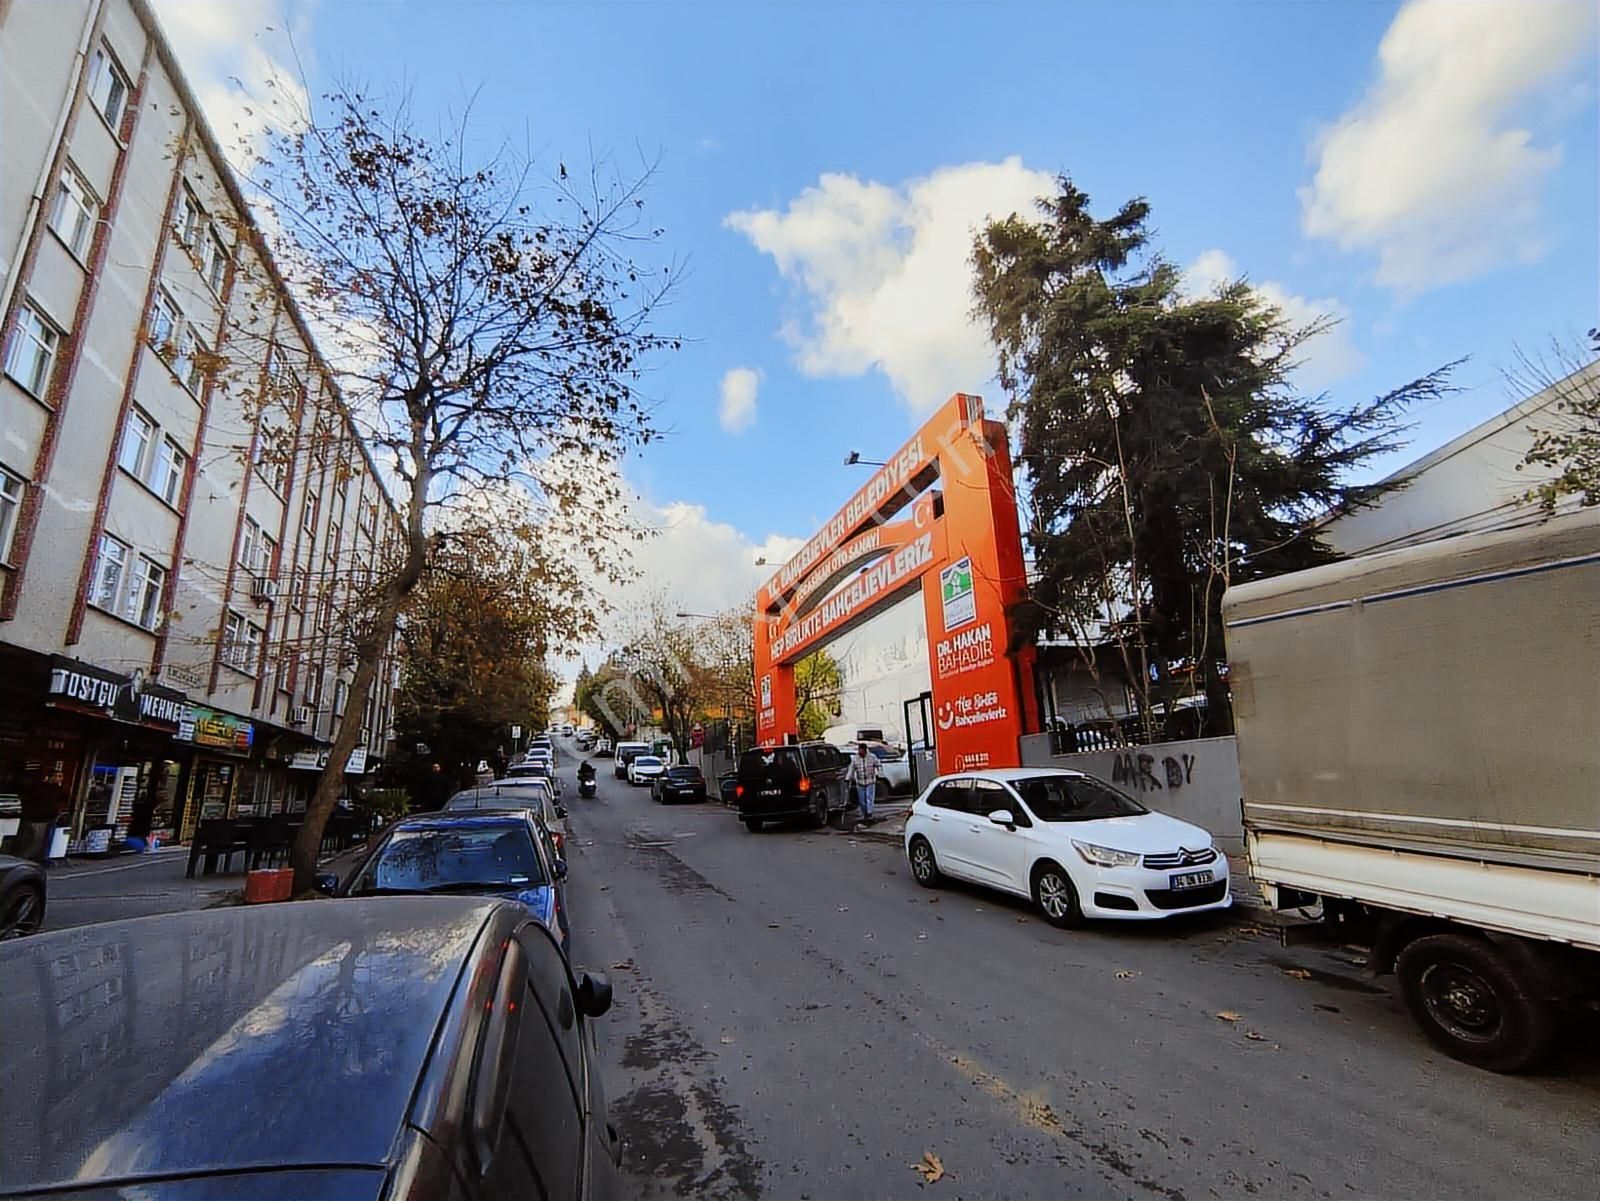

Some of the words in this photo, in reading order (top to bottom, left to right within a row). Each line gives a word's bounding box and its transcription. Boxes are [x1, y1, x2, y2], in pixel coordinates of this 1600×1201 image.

[832, 549, 848, 570] OTO
[953, 624, 991, 649] HAKAN
[938, 641, 993, 673] BAHADIR
